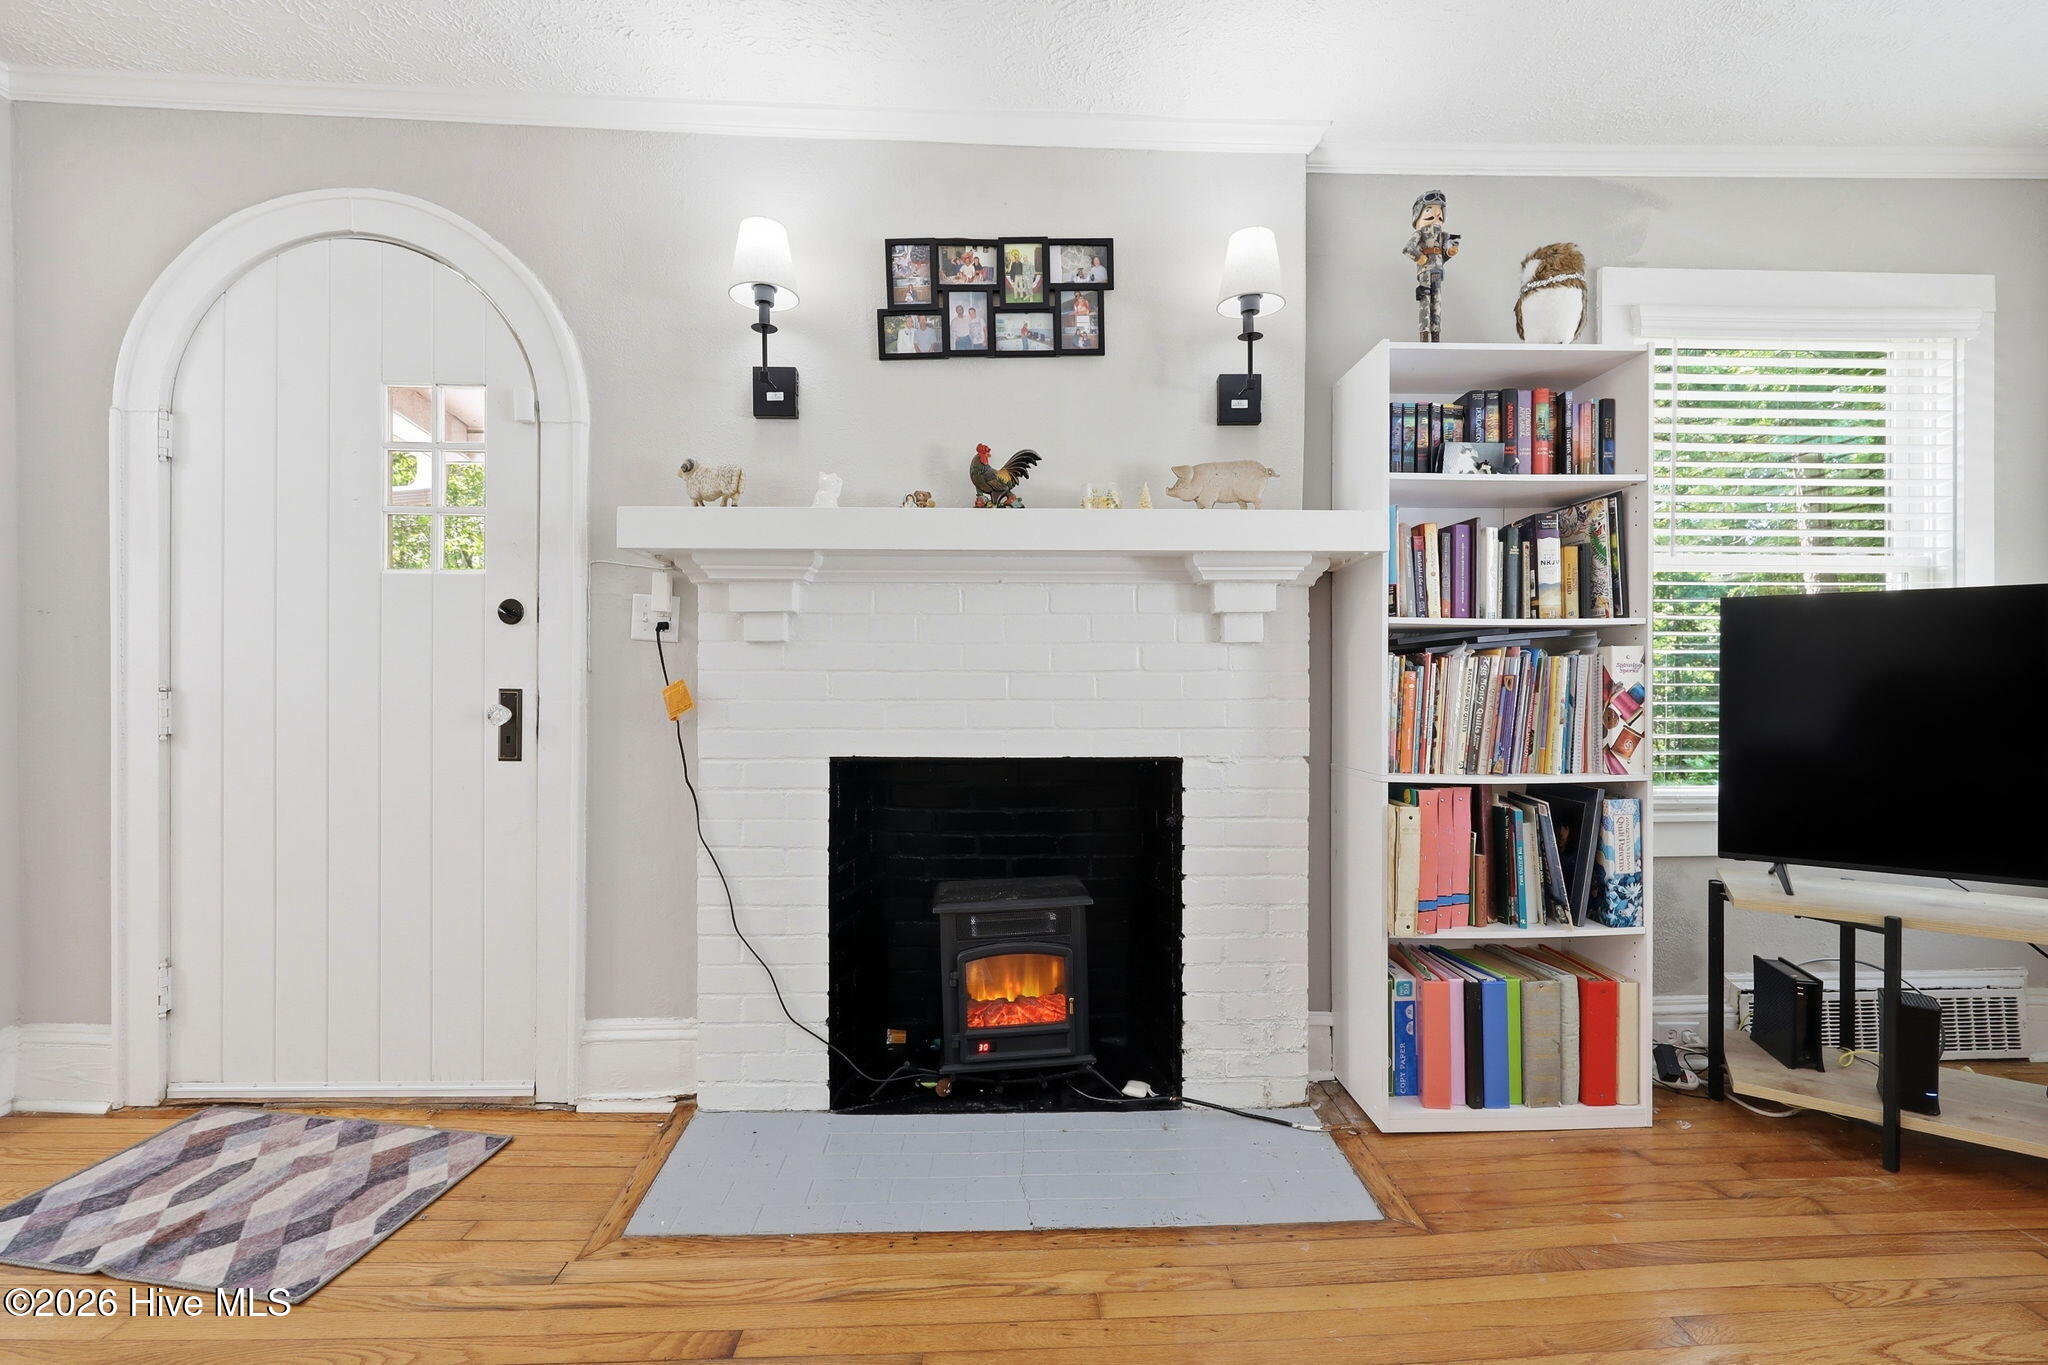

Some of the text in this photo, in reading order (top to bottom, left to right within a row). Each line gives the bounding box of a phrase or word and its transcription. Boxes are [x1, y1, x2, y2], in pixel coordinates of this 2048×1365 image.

[1461, 667, 1473, 733] BACKYARD BIRD QUILTS
[1476, 678, 1488, 706] Money
[1474, 708, 1484, 734] Quilts
[1616, 816, 1626, 837] Quilt
[1399, 1043, 1407, 1070] PAPER
